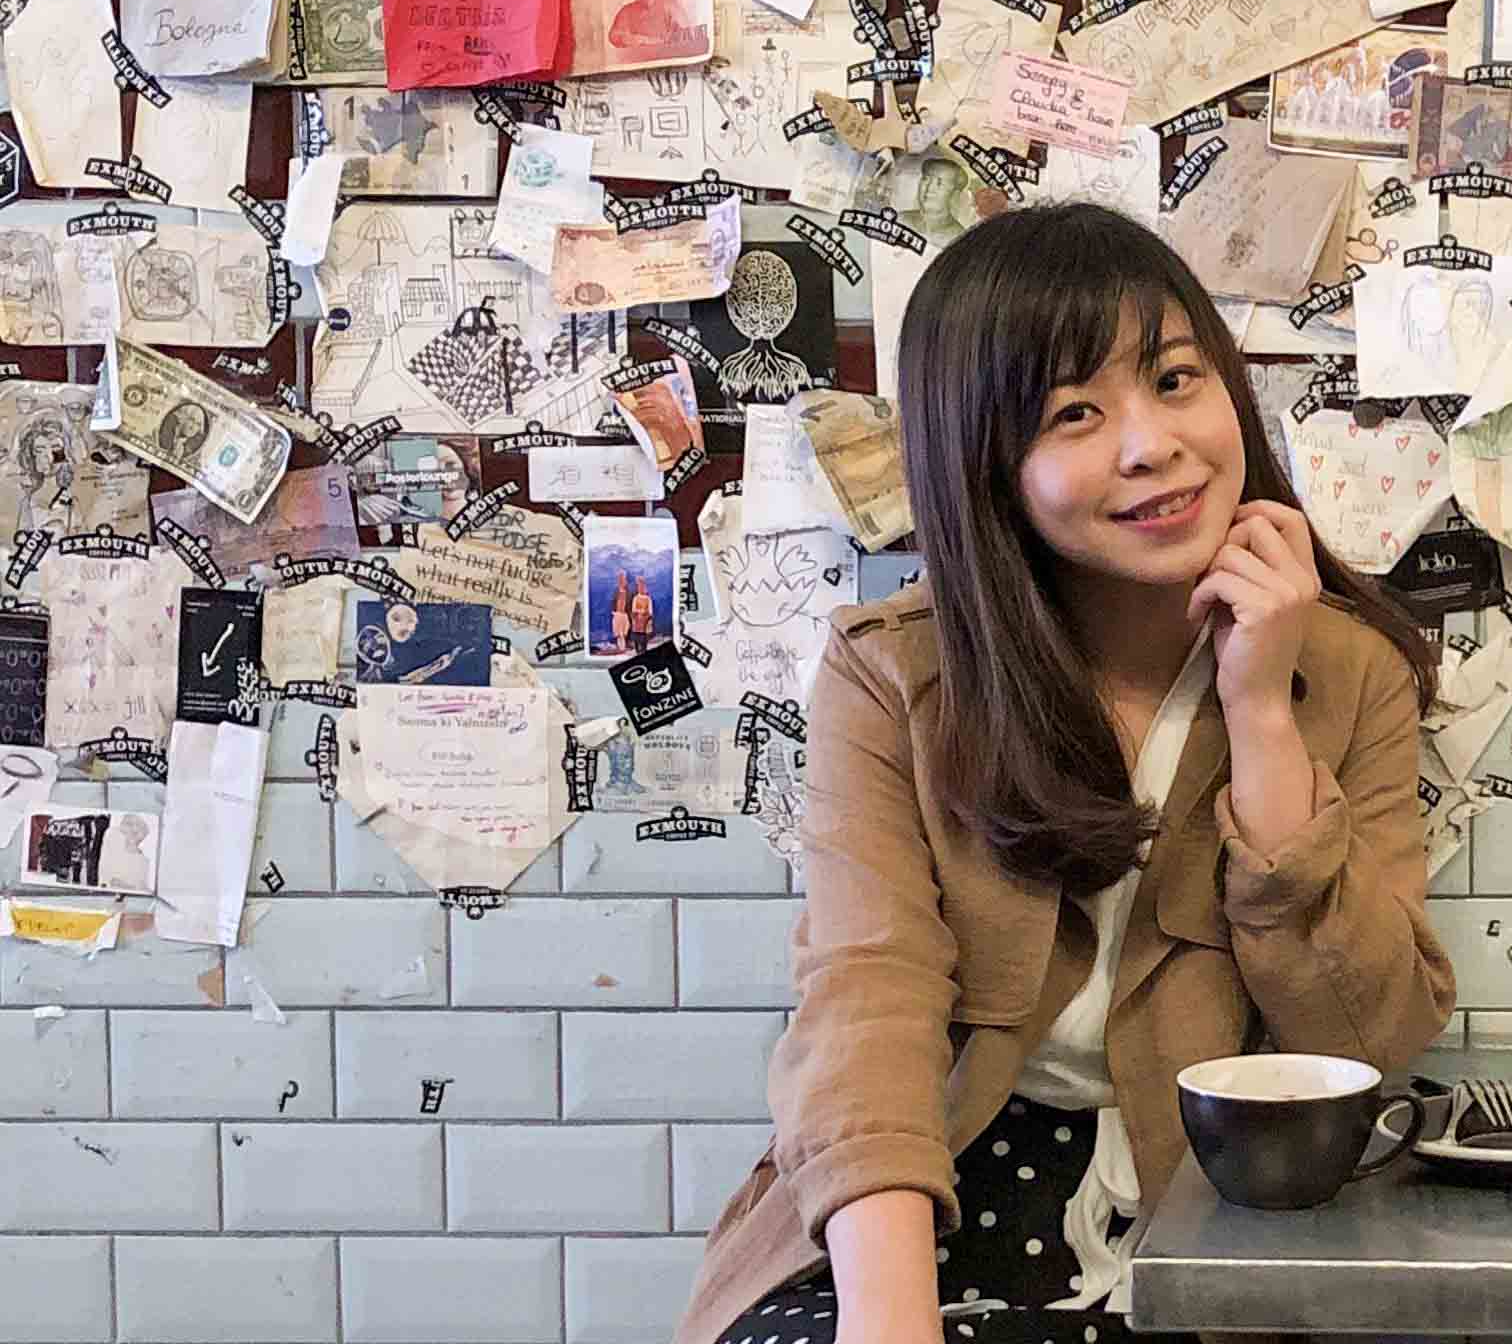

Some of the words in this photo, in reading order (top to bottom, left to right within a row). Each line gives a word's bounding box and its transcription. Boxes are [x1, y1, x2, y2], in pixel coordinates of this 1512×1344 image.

[848, 58, 932, 81] EXMOUTH
[85, 159, 172, 203] EXMOUTH
[1161, 138, 1228, 212] EXMOUTH
[670, 183, 757, 203] EXMOUTH
[67, 215, 156, 236] EXMOUTH
[617, 206, 706, 233] EXMOUTH
[840, 210, 927, 252] EXMOUTH
[787, 216, 861, 284] EXMOUTH
[1404, 247, 1492, 270] EXMOUTH
[644, 319, 721, 374] EXMOUTH
[327, 477, 343, 499] 5
[448, 482, 518, 539] EXMOUTH
[60, 537, 148, 553] EXMOUTH
[158, 521, 223, 588] EXMOUTH
[334, 560, 414, 600] EXMOUTH
[288, 683, 357, 702] EXMOUT
[636, 822, 726, 838] EXMOUTH
